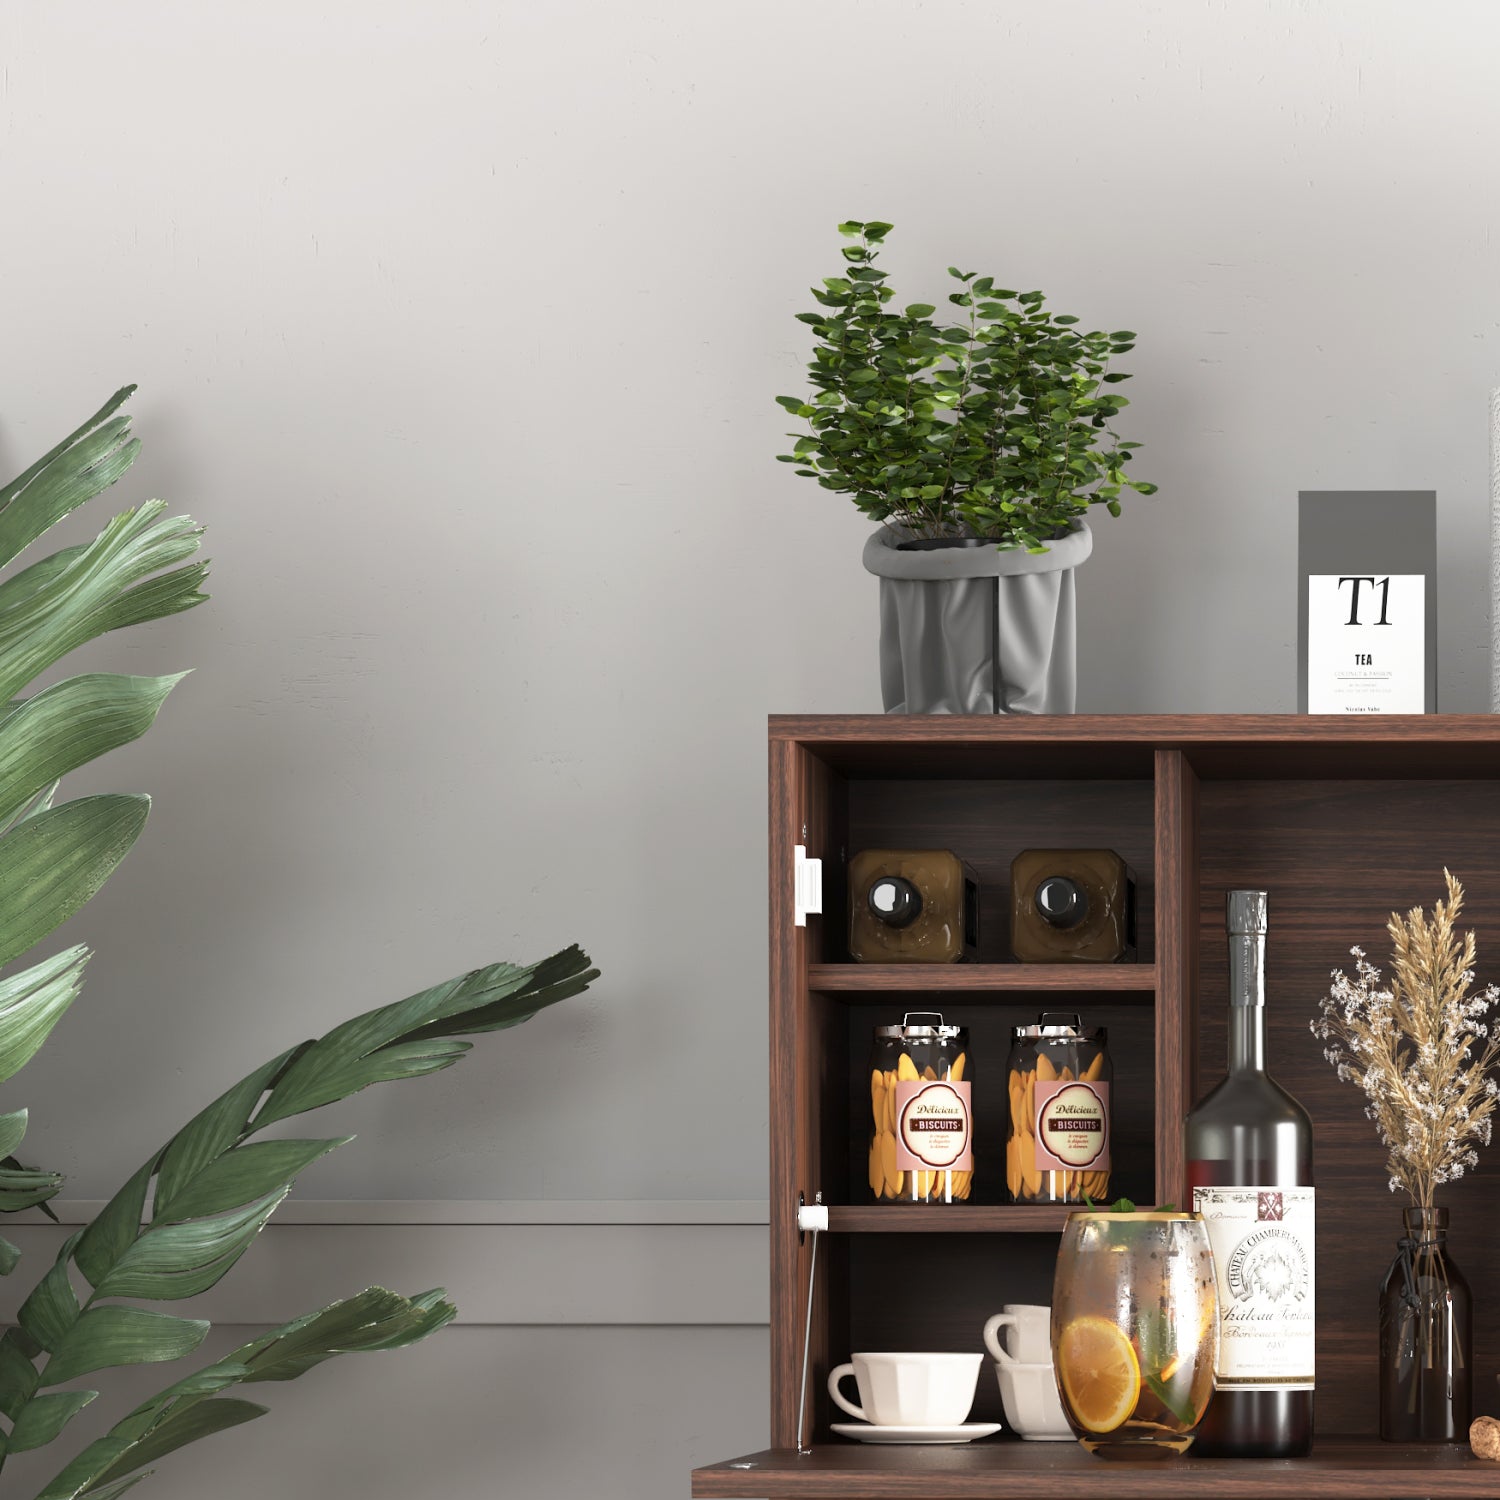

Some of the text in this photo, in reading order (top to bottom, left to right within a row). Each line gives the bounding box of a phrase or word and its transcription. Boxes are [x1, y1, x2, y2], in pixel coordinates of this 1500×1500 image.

[1338, 576, 1392, 625] T1
[1355, 654, 1373, 665] TEA
[1056, 1105, 1098, 1114] Délicieux
[919, 1121, 958, 1129] BISCUITS
[1058, 1121, 1096, 1129] BISCUITS
